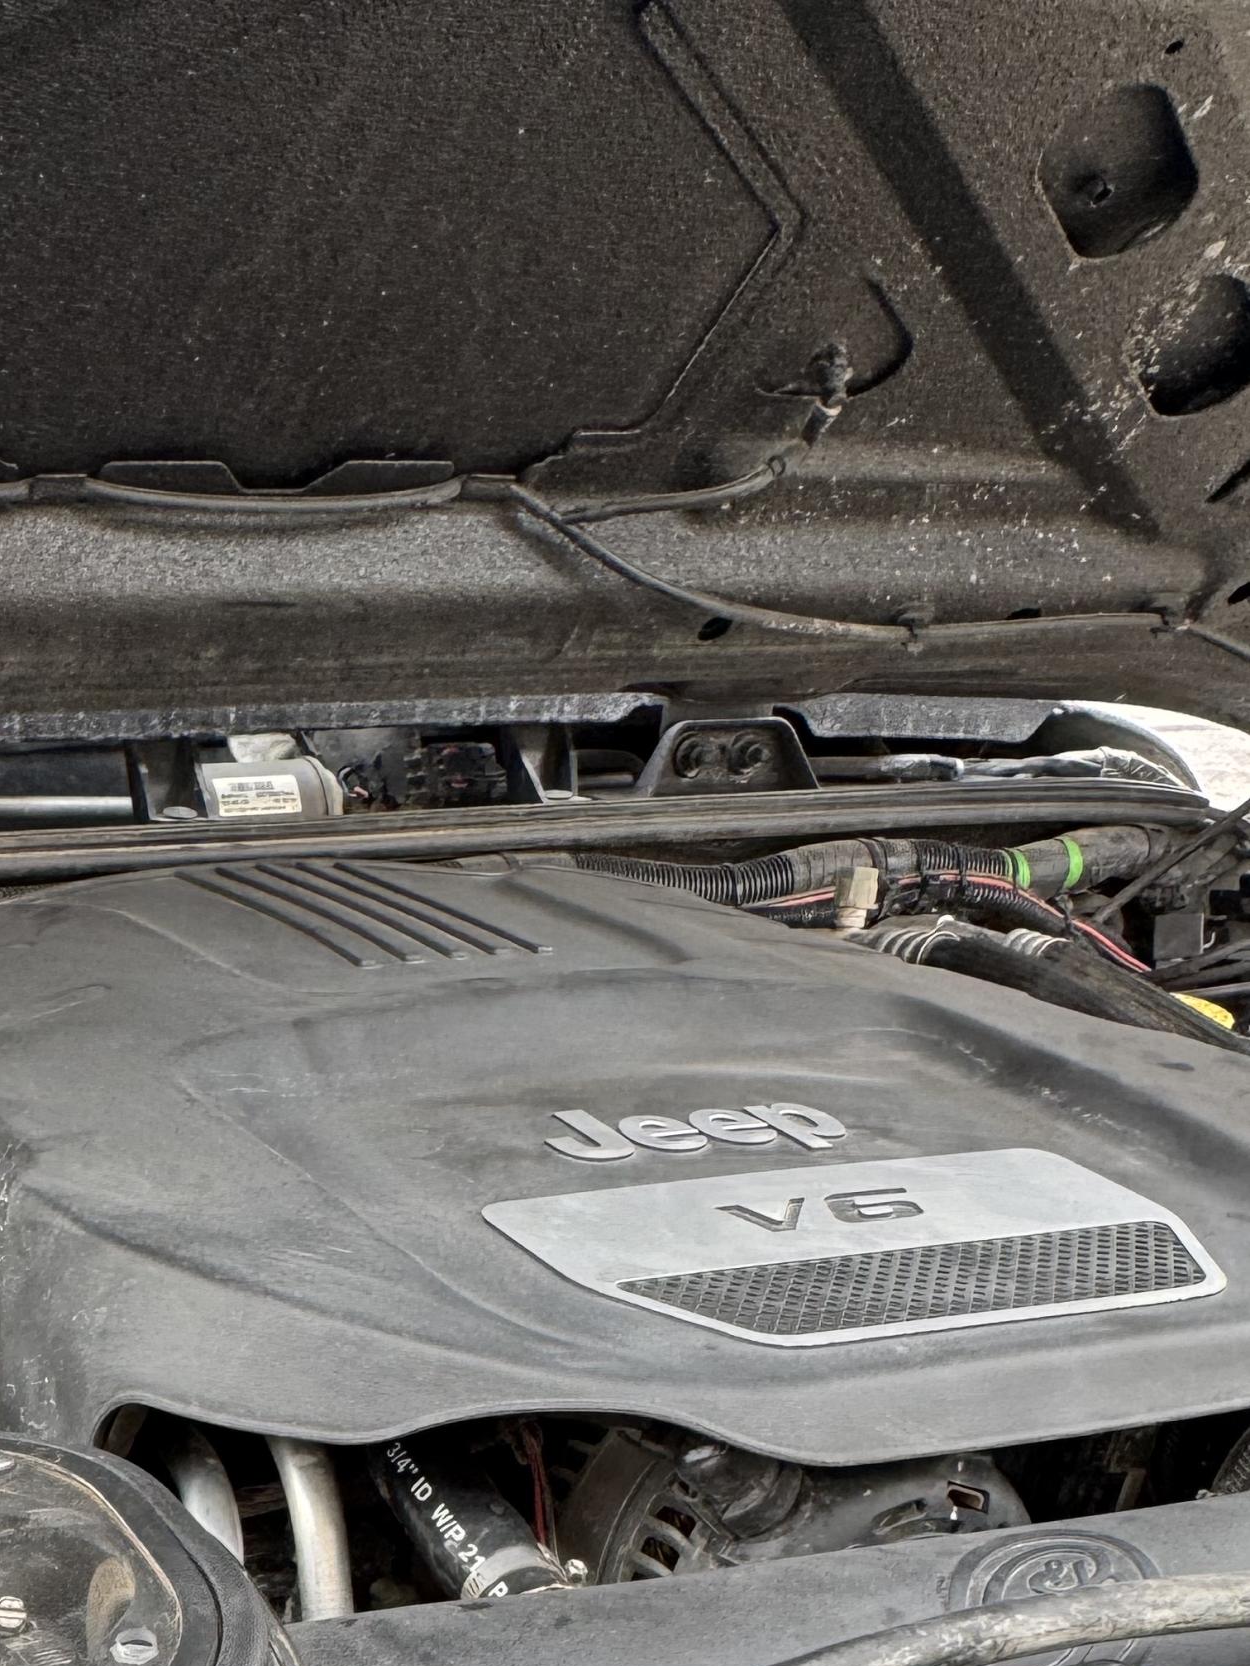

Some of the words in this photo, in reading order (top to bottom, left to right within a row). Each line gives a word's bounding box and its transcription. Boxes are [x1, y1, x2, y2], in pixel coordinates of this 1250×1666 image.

[544, 1102, 847, 1162] Jeep
[716, 1188, 924, 1232] V6
[410, 1476, 433, 1501] ID
[431, 1503, 466, 1544] W/P
